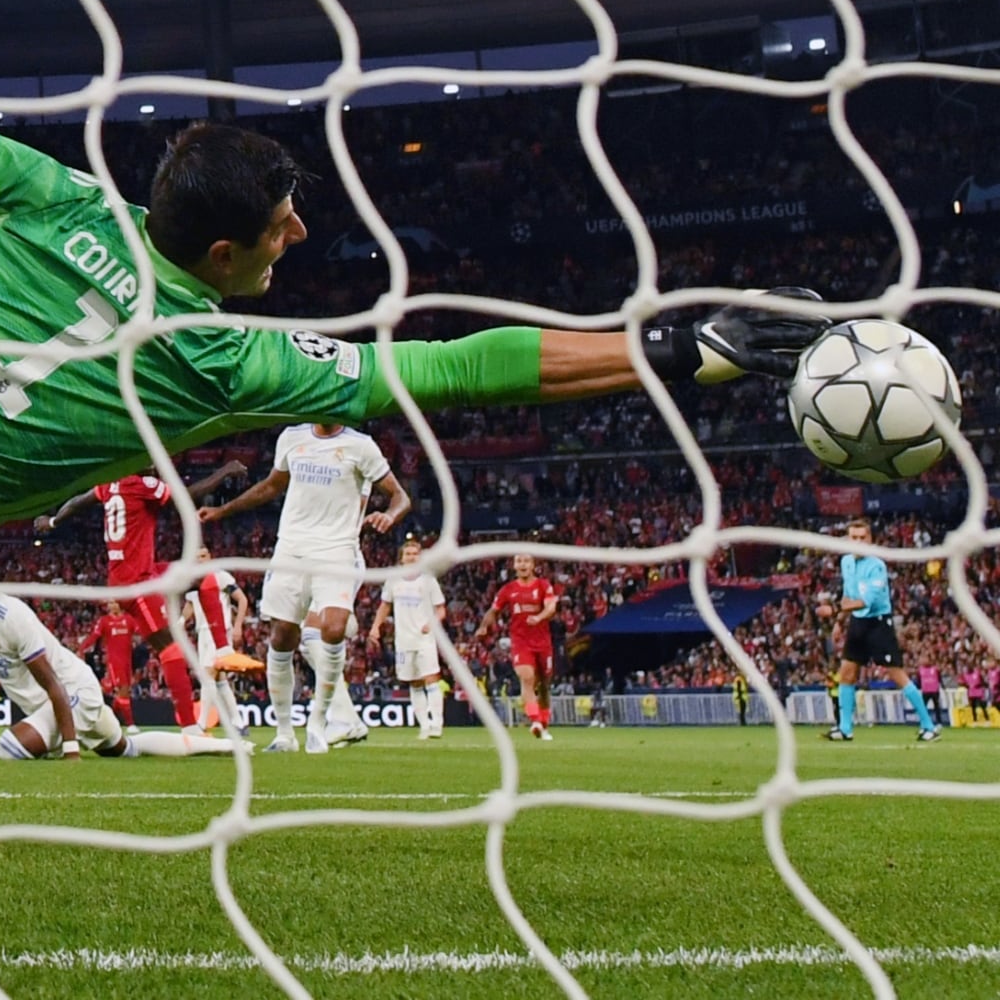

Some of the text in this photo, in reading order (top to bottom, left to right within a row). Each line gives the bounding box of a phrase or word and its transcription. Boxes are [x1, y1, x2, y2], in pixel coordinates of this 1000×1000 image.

[644, 208, 736, 230] HAMPIONS
[741, 200, 808, 221] LEAGUE
[291, 460, 341, 477] Emirates
